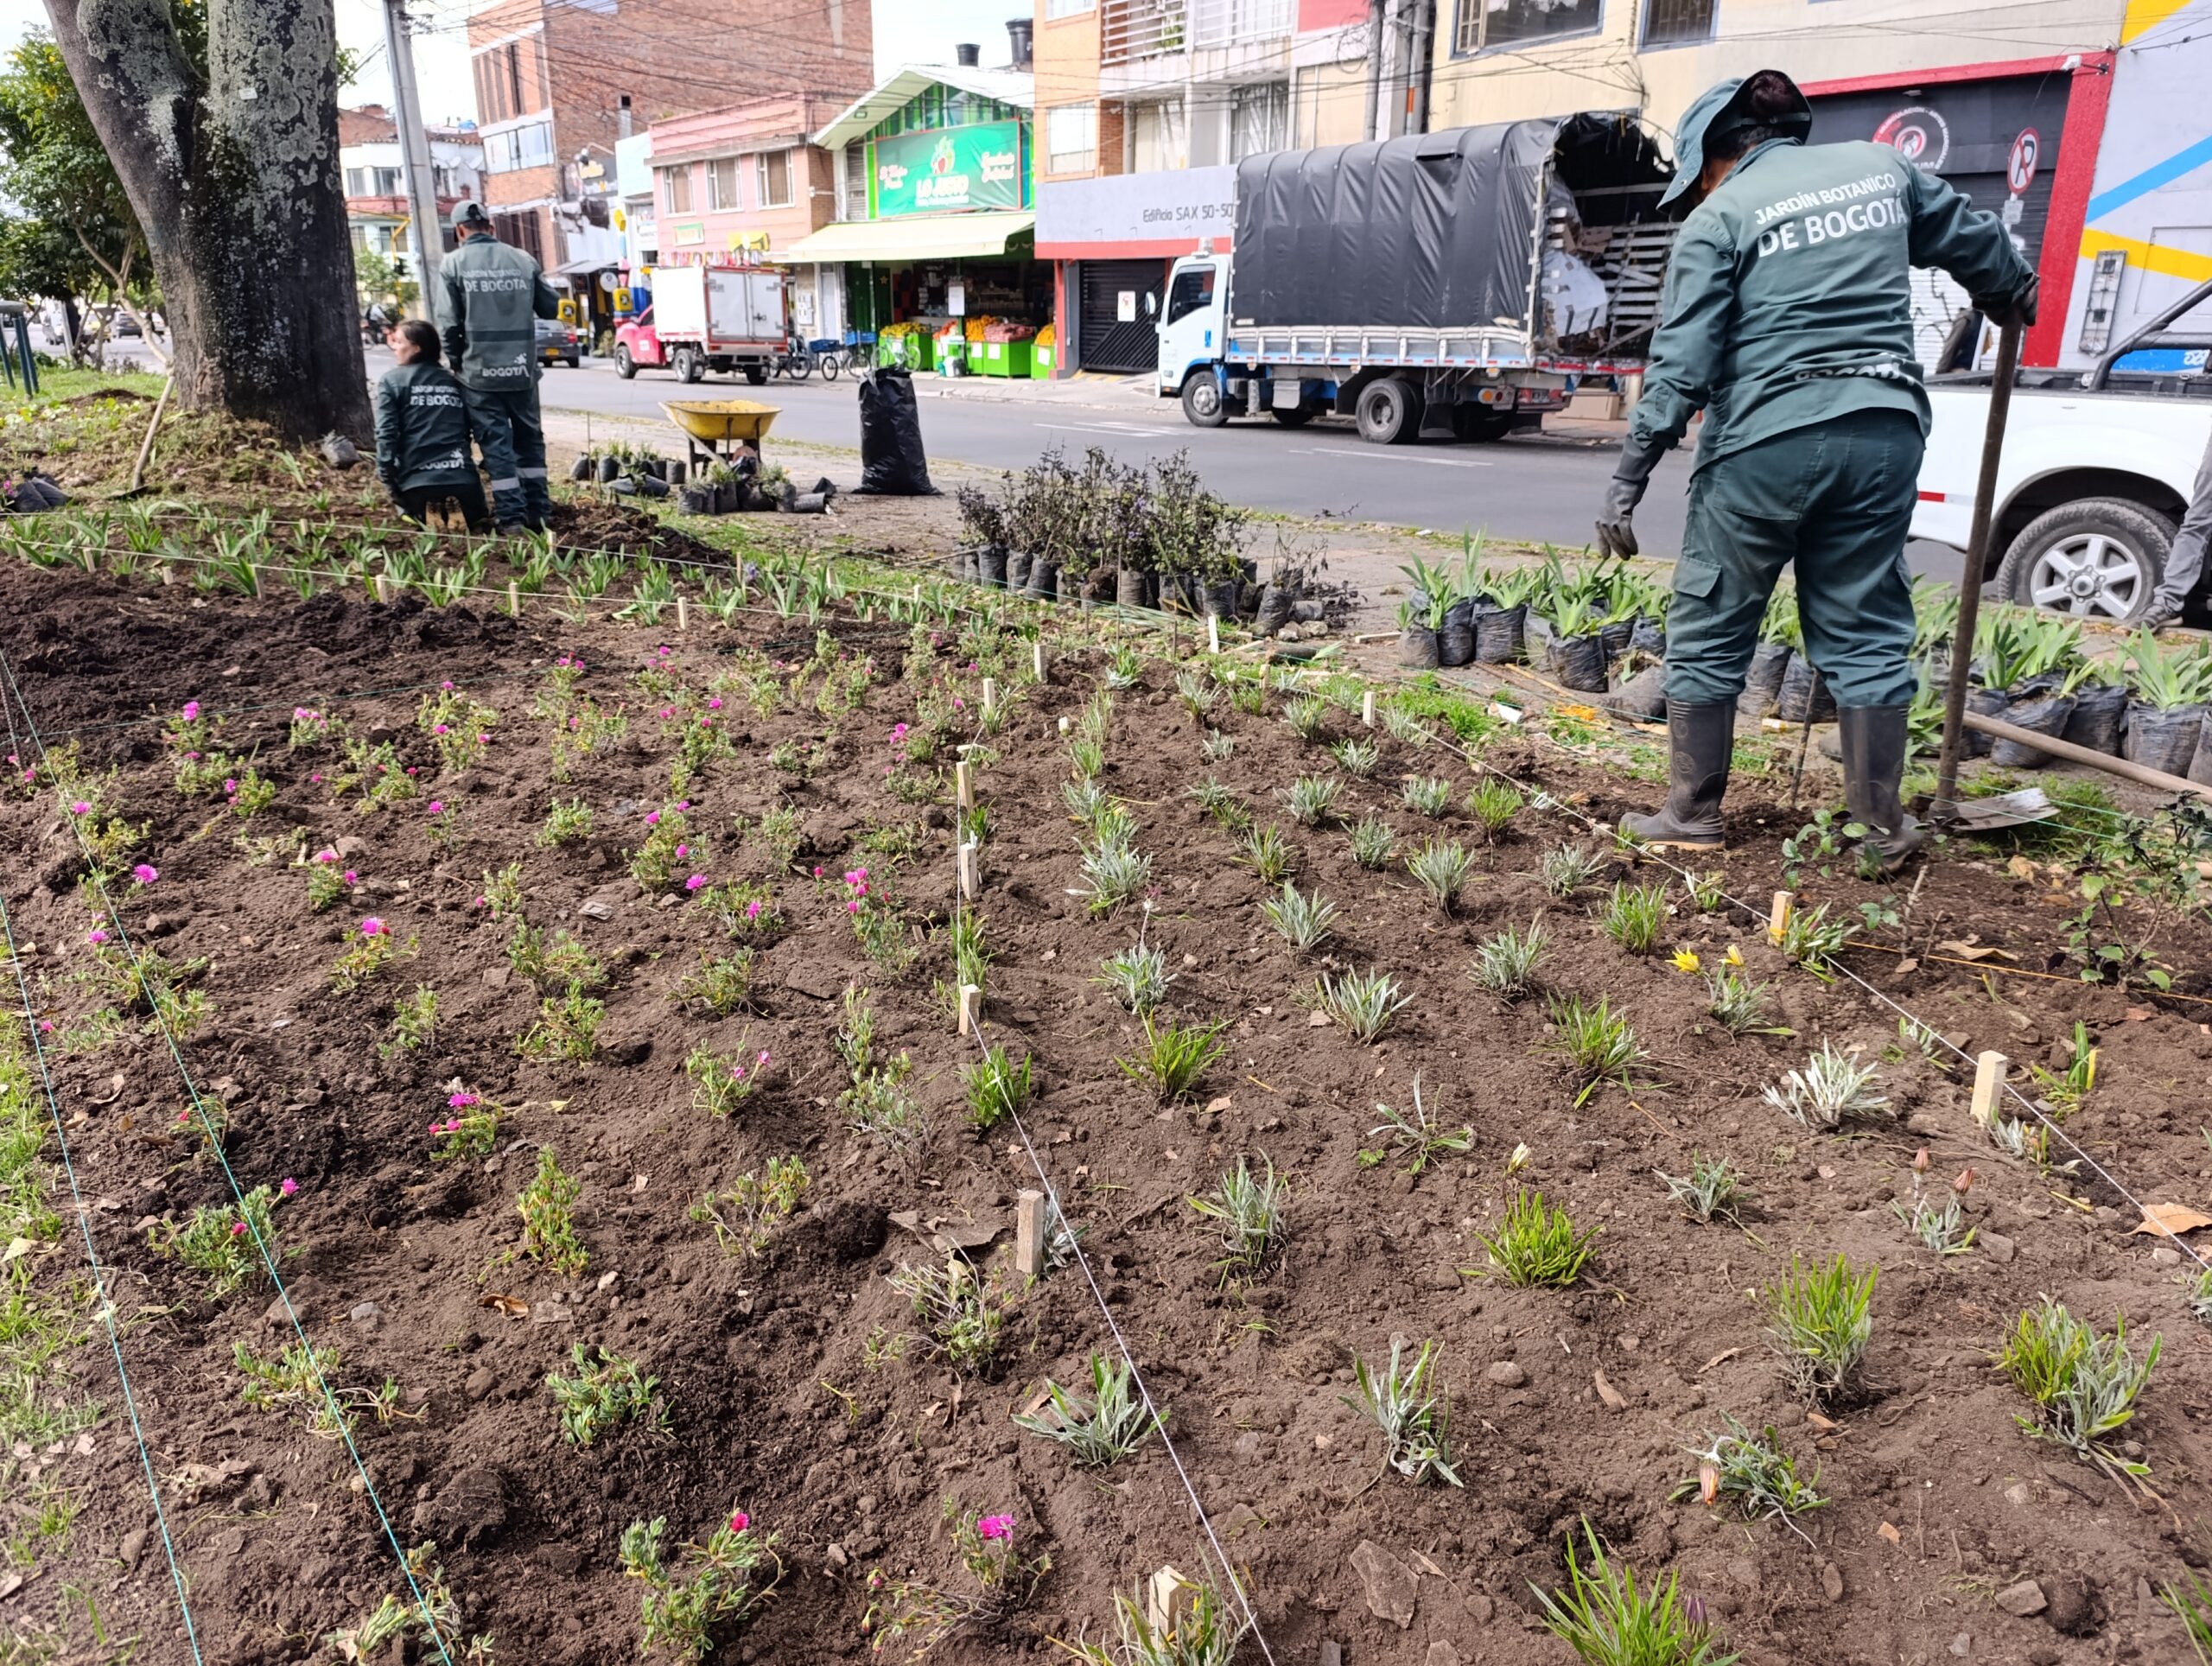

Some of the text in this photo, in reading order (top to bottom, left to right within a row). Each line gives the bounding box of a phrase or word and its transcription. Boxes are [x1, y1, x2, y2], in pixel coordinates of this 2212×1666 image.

[1176, 206, 1198, 221] SAX
[1754, 191, 1821, 225] JARDÍN
[1758, 188, 1907, 258] DE BOGOTÁ
[464, 279, 479, 292] DE
[410, 396, 425, 406] DE
